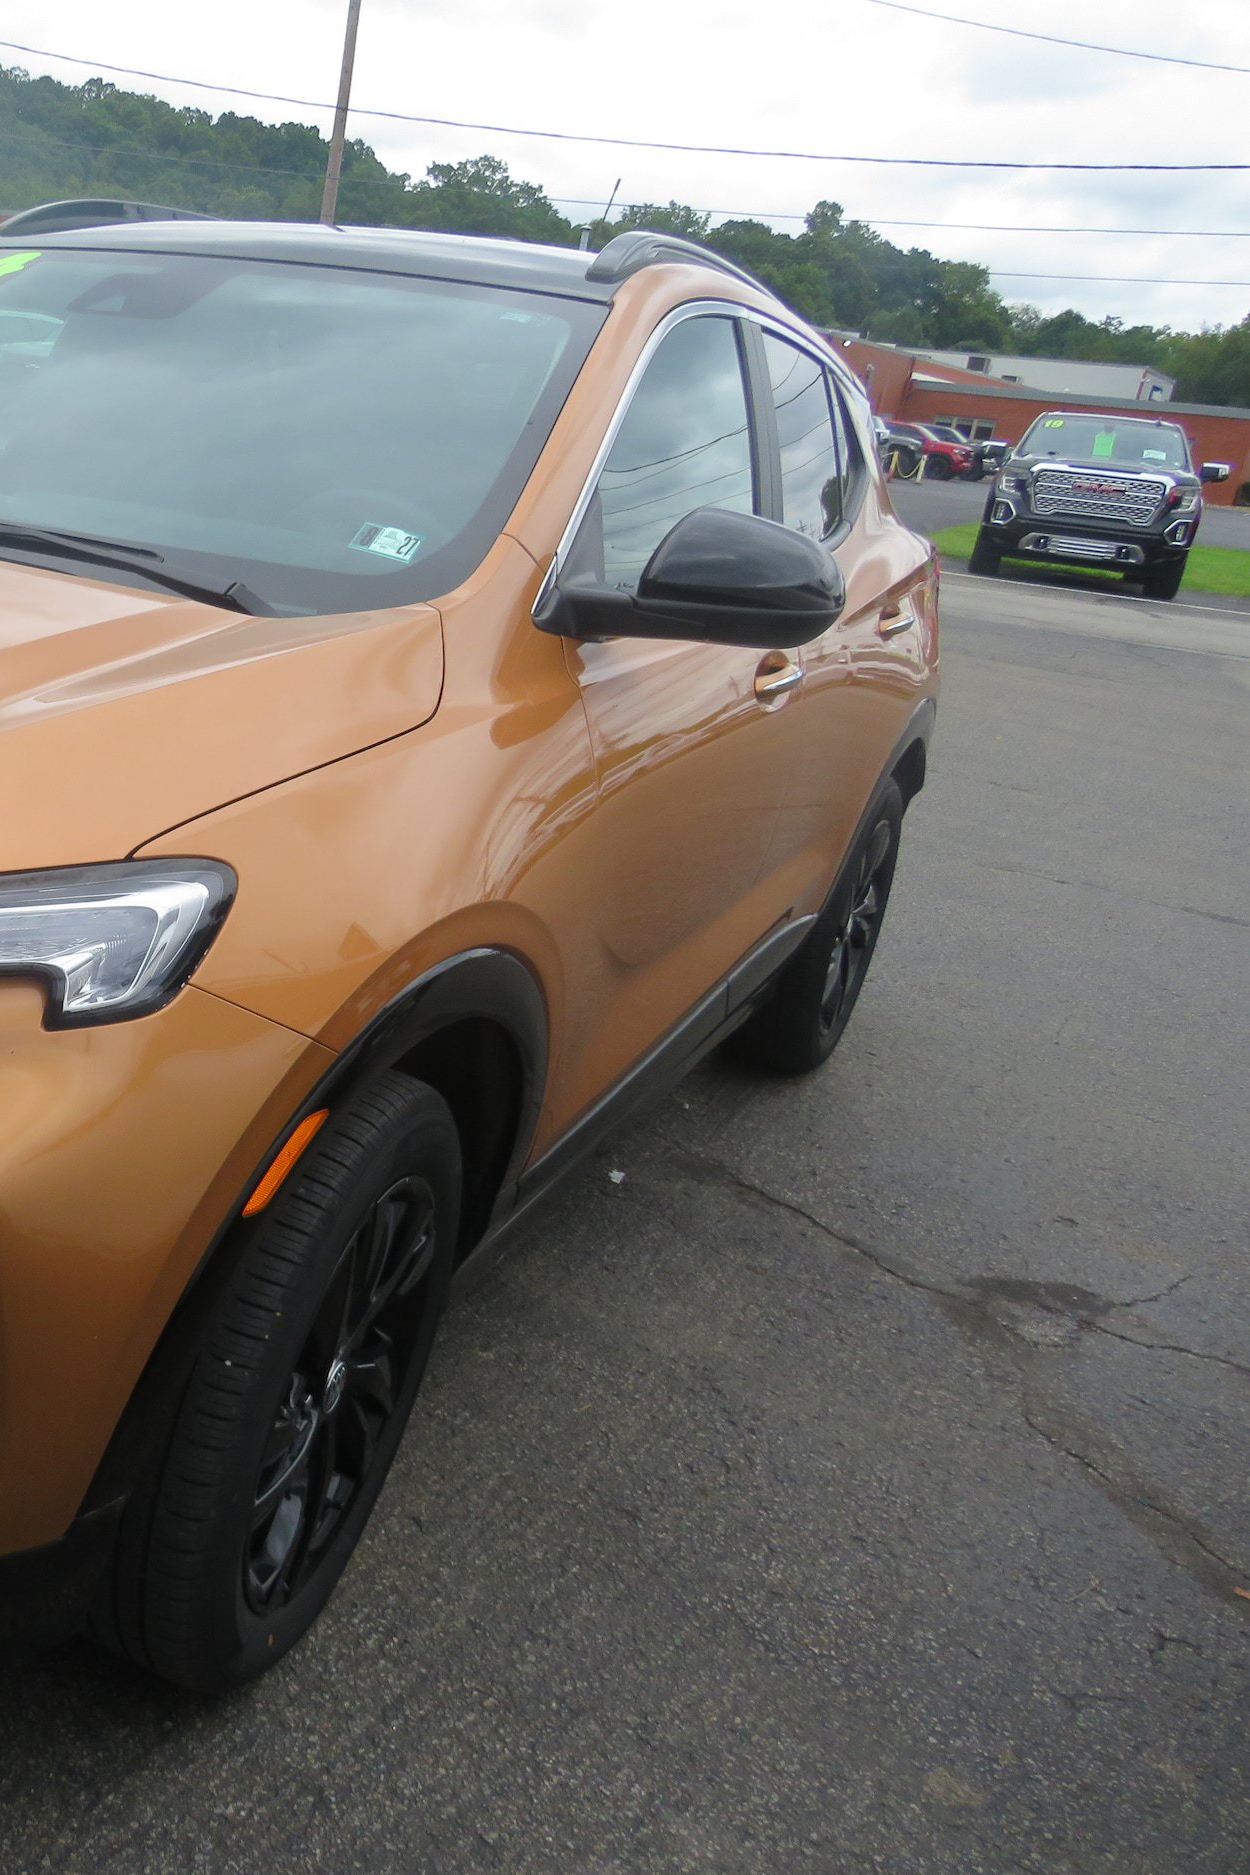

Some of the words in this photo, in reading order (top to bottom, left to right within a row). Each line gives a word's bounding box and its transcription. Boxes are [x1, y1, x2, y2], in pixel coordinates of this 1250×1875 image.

[1043, 419, 1064, 429] 19
[1072, 481, 1126, 497] GMC
[396, 535, 421, 558] 27
